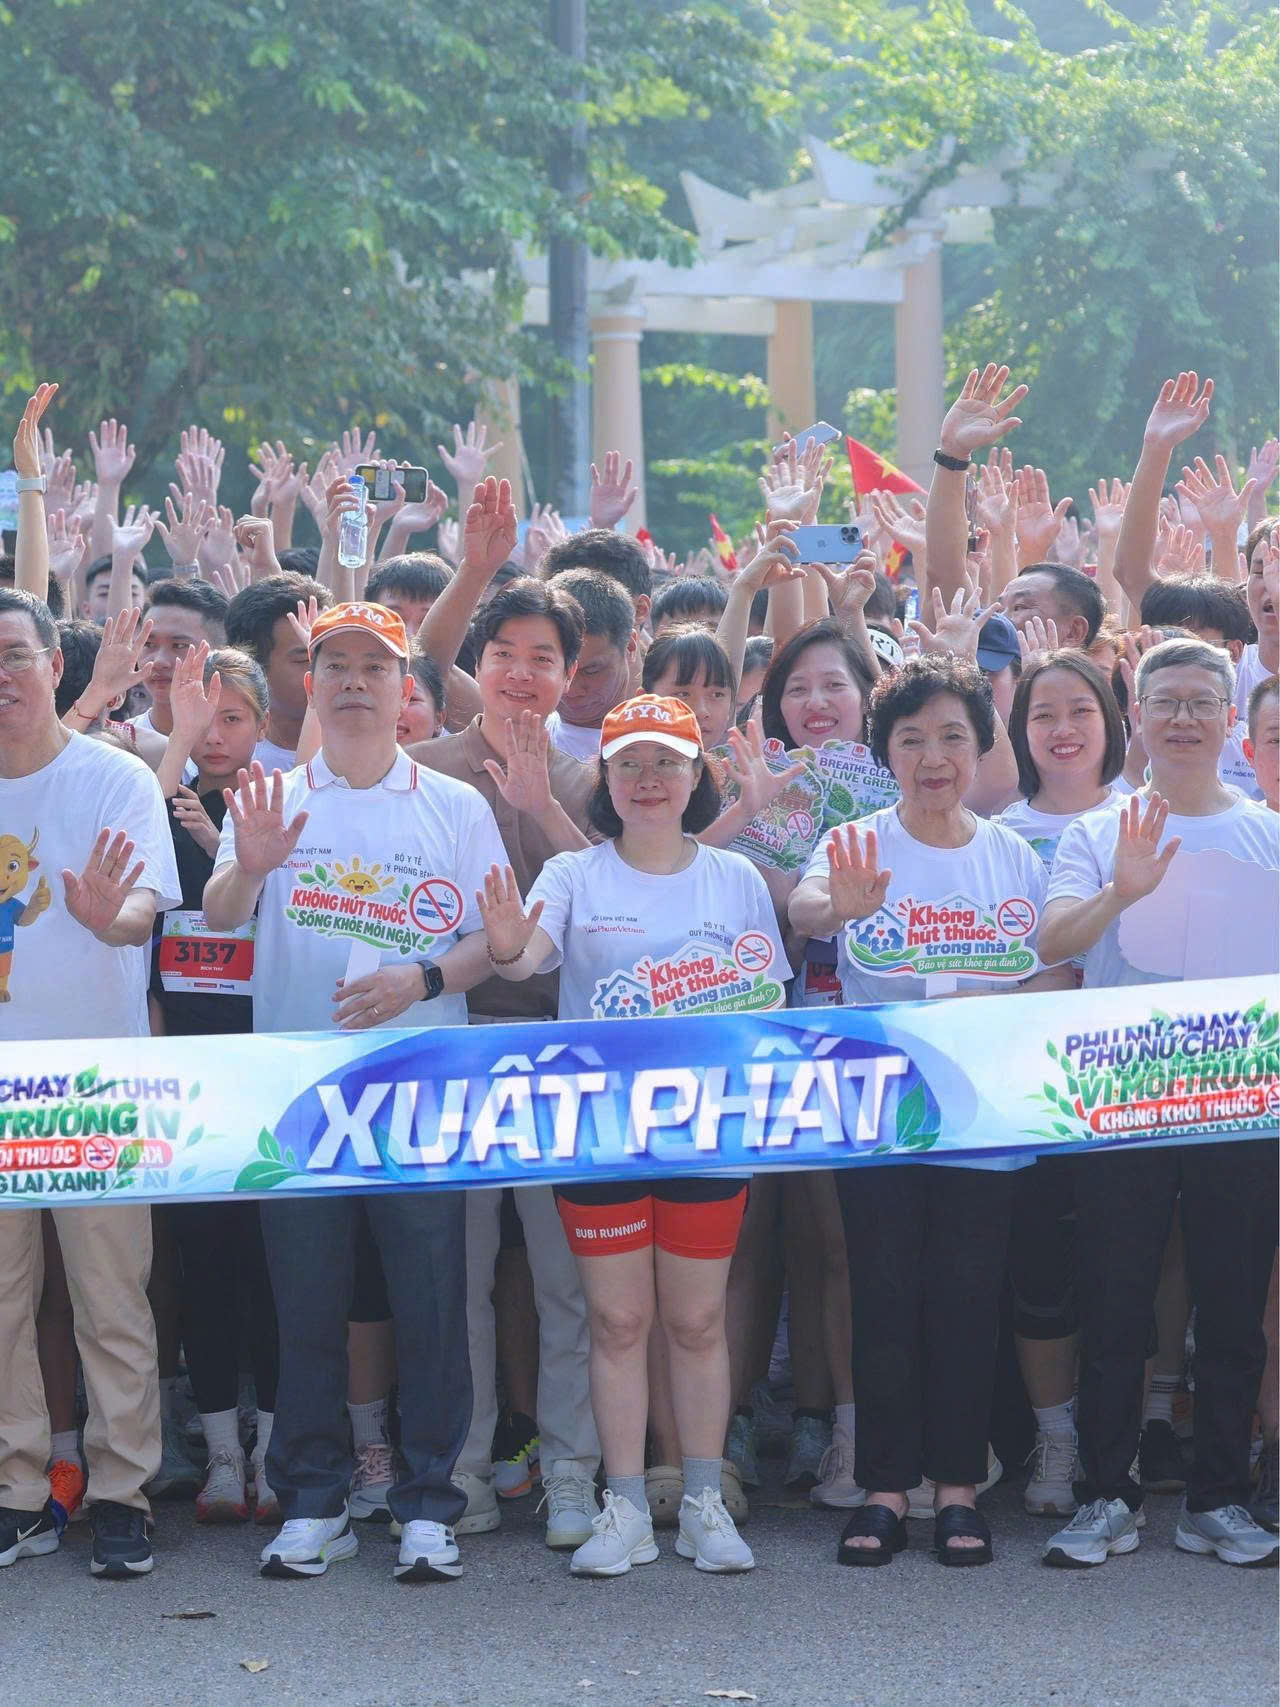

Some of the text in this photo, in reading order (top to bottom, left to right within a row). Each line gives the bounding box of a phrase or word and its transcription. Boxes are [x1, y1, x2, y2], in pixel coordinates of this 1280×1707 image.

[336, 606, 384, 626] TYM
[624, 704, 672, 723] TYM
[820, 758, 867, 774] BREATHE
[870, 768, 895, 780] CLEA
[833, 770, 899, 790] LIVE GREEN
[394, 854, 404, 862] BỘ
[292, 887, 408, 925] KHÔNG HÚT THUỐC
[909, 906, 975, 928] Không
[296, 909, 332, 928] SỐNG
[364, 921, 385, 938] MỖI
[386, 928, 420, 947] NGÀY
[908, 924, 996, 946] hút thuốc
[174, 941, 236, 964] 3137
[926, 938, 1006, 956] trong nhà
[650, 956, 714, 988] Không
[918, 960, 934, 970] Bảo
[949, 959, 961, 967] sức
[984, 960, 997, 969] gia
[652, 967, 740, 1008] hút thuốc
[673, 978, 752, 1012] trong nhà
[1080, 1043, 1134, 1070] PHỤ
[1182, 1023, 1254, 1057] CHẠY
[306, 1044, 608, 1170] XUẤT
[1100, 1088, 1260, 1131] KHÔNG KHÓI THUỐC
[15, 1141, 76, 1166] THUỐC
[12, 1174, 42, 1194] LAI
[48, 1170, 106, 1192] XANH
[576, 1218, 647, 1239] BUBI RUNNING
